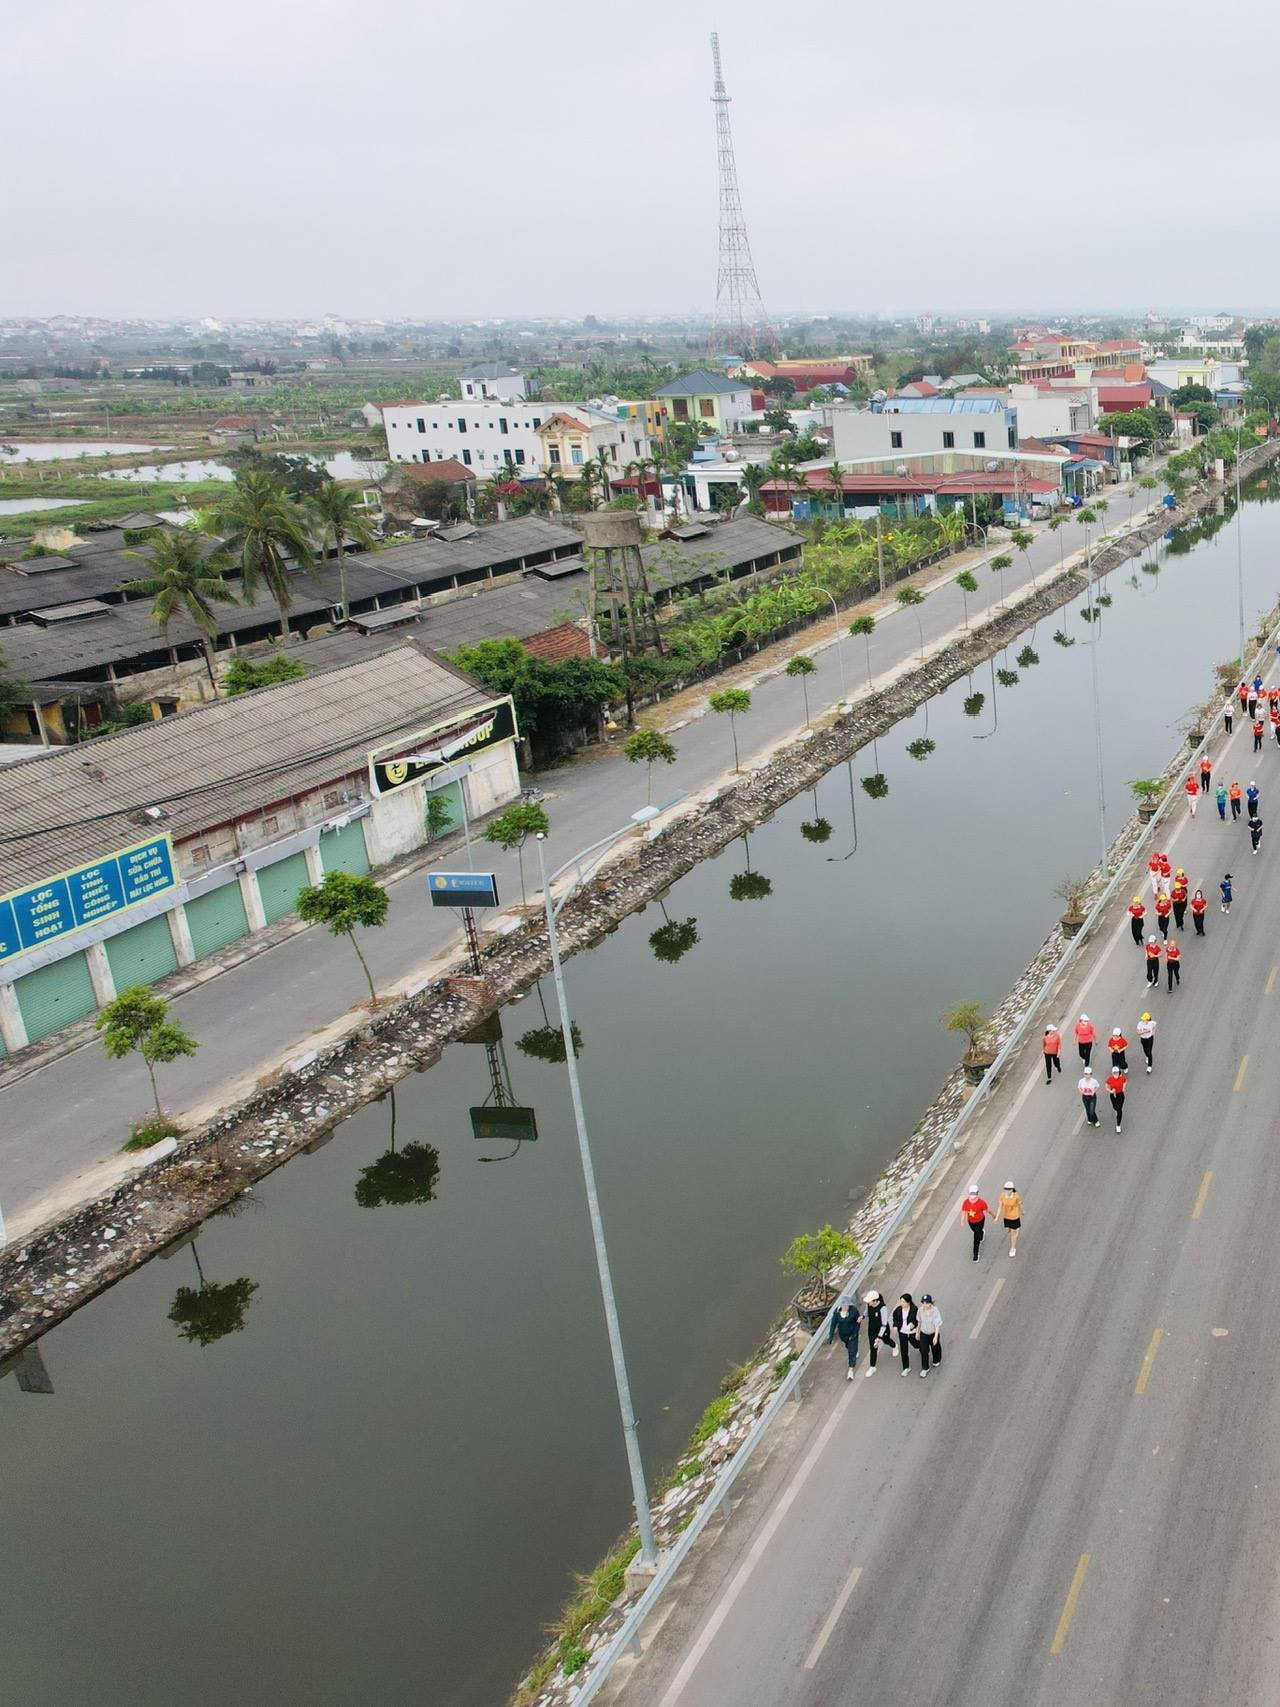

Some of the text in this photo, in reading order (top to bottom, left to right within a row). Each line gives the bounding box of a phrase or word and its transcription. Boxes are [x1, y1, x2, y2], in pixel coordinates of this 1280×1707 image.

[81, 869, 100, 880] LỌC
[80, 877, 103, 890] TINH
[82, 883, 109, 900] KHIẾT
[31, 889, 53, 903] LỌC
[84, 894, 110, 909] CÔNG
[83, 900, 118, 919] NGHIỆP
[32, 910, 60, 927] SINH
[34, 921, 64, 938] HOẠT
